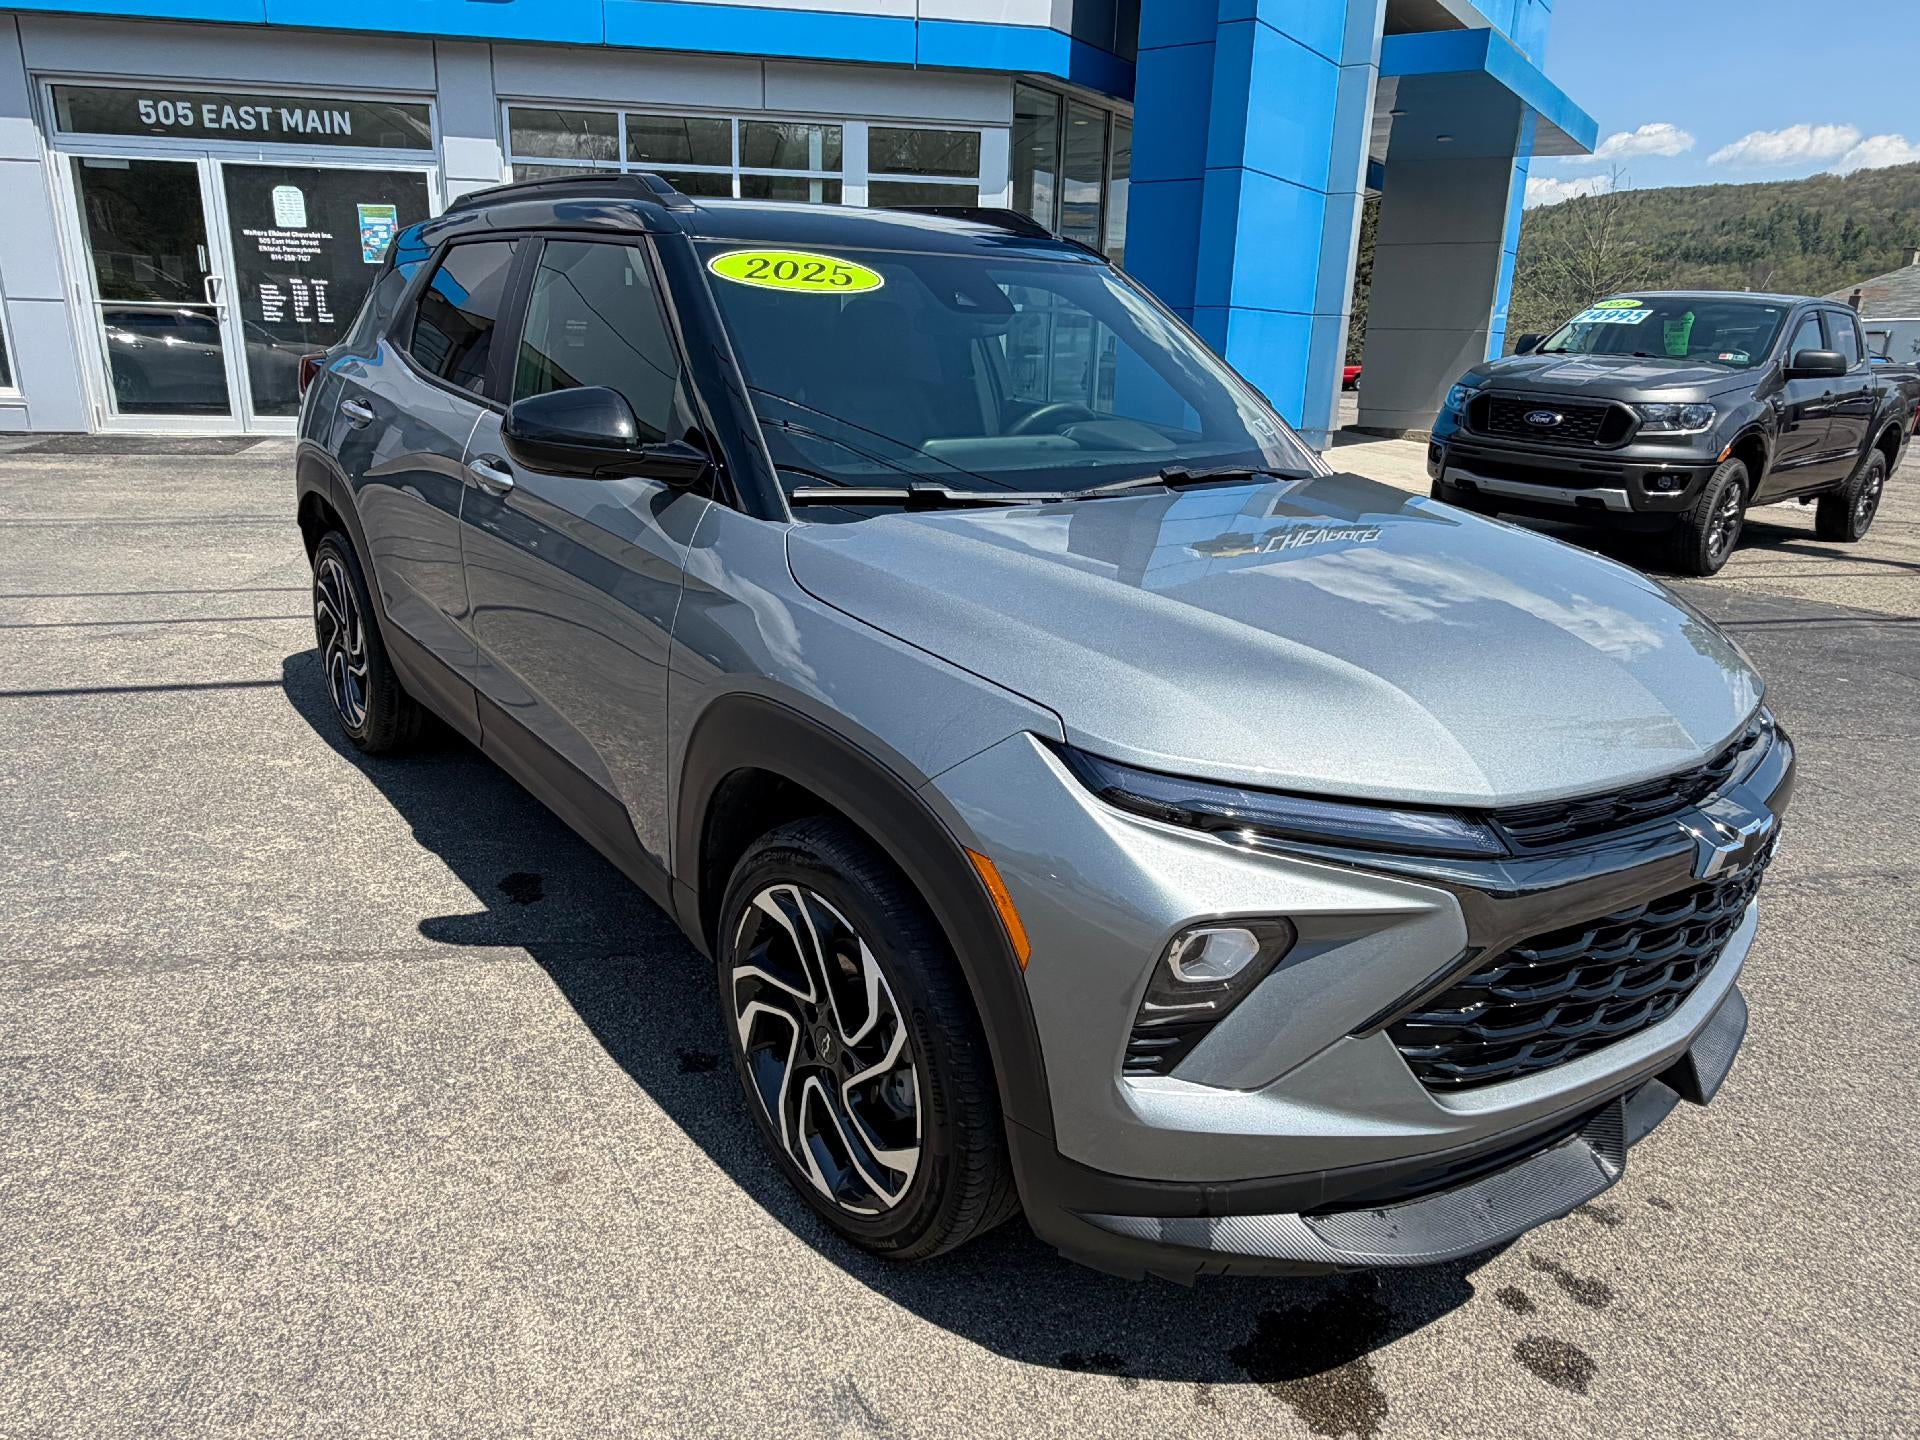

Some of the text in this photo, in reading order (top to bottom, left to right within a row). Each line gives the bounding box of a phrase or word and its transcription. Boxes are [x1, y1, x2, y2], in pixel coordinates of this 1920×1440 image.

[138, 99, 352, 136] 505 EAST MAIN
[268, 229, 291, 237] Elkland
[291, 231, 321, 239] Chevrolet
[258, 237, 271, 245] 505
[271, 237, 285, 245] East
[282, 245, 321, 254] Pennsylvania
[744, 258, 853, 286] 2025
[1529, 413, 1552, 424] Ford
